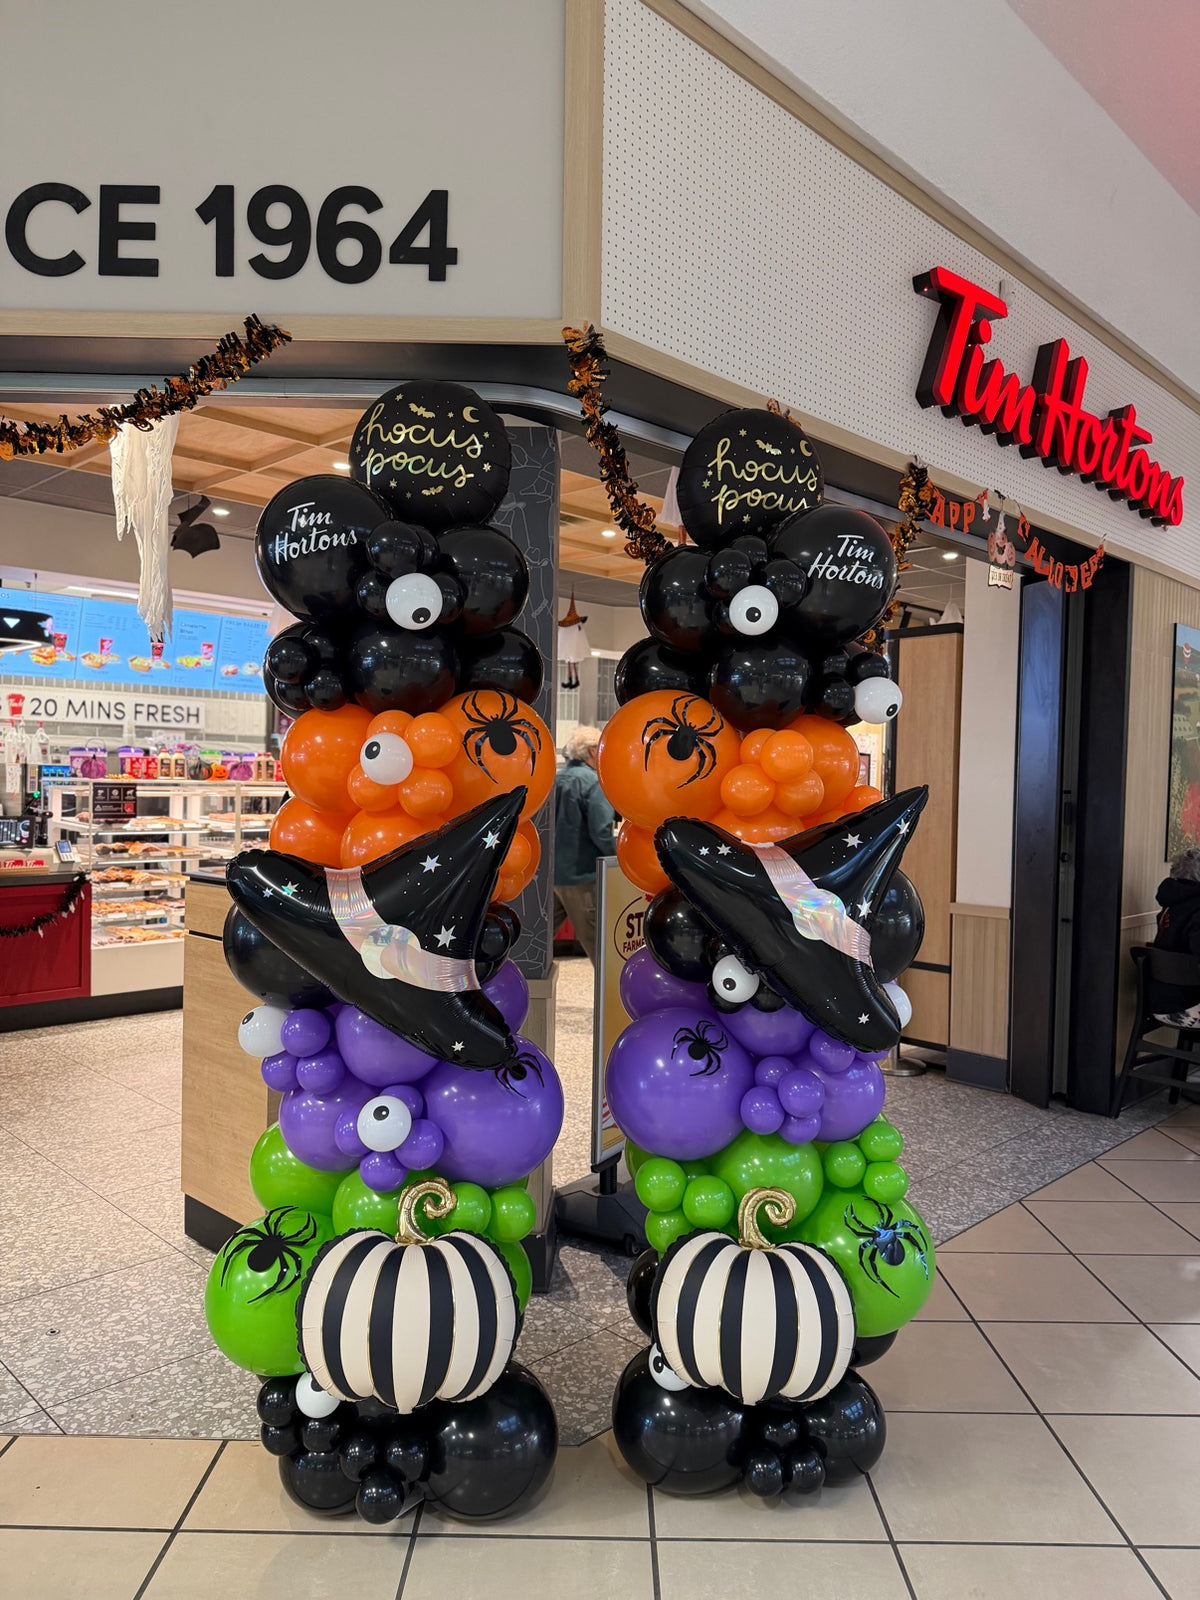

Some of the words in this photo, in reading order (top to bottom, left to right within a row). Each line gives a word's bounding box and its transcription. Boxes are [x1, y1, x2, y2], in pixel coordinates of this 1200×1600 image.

[5, 182, 160, 277] CE
[195, 184, 458, 284] 1964
[913, 266, 1036, 447] Tim
[1027, 337, 1185, 527] Hortons
[361, 403, 483, 458] hocus
[360, 448, 475, 489] pocus
[707, 437, 818, 492] hocus
[287, 502, 332, 532] Tim
[274, 527, 358, 565] Hortons
[837, 534, 875, 563] Tim
[807, 552, 884, 590] Hortons
[30, 697, 58, 717] 20
[66, 699, 126, 721] MINS
[134, 703, 200, 724] FRESH
[626, 912, 646, 939] ST
